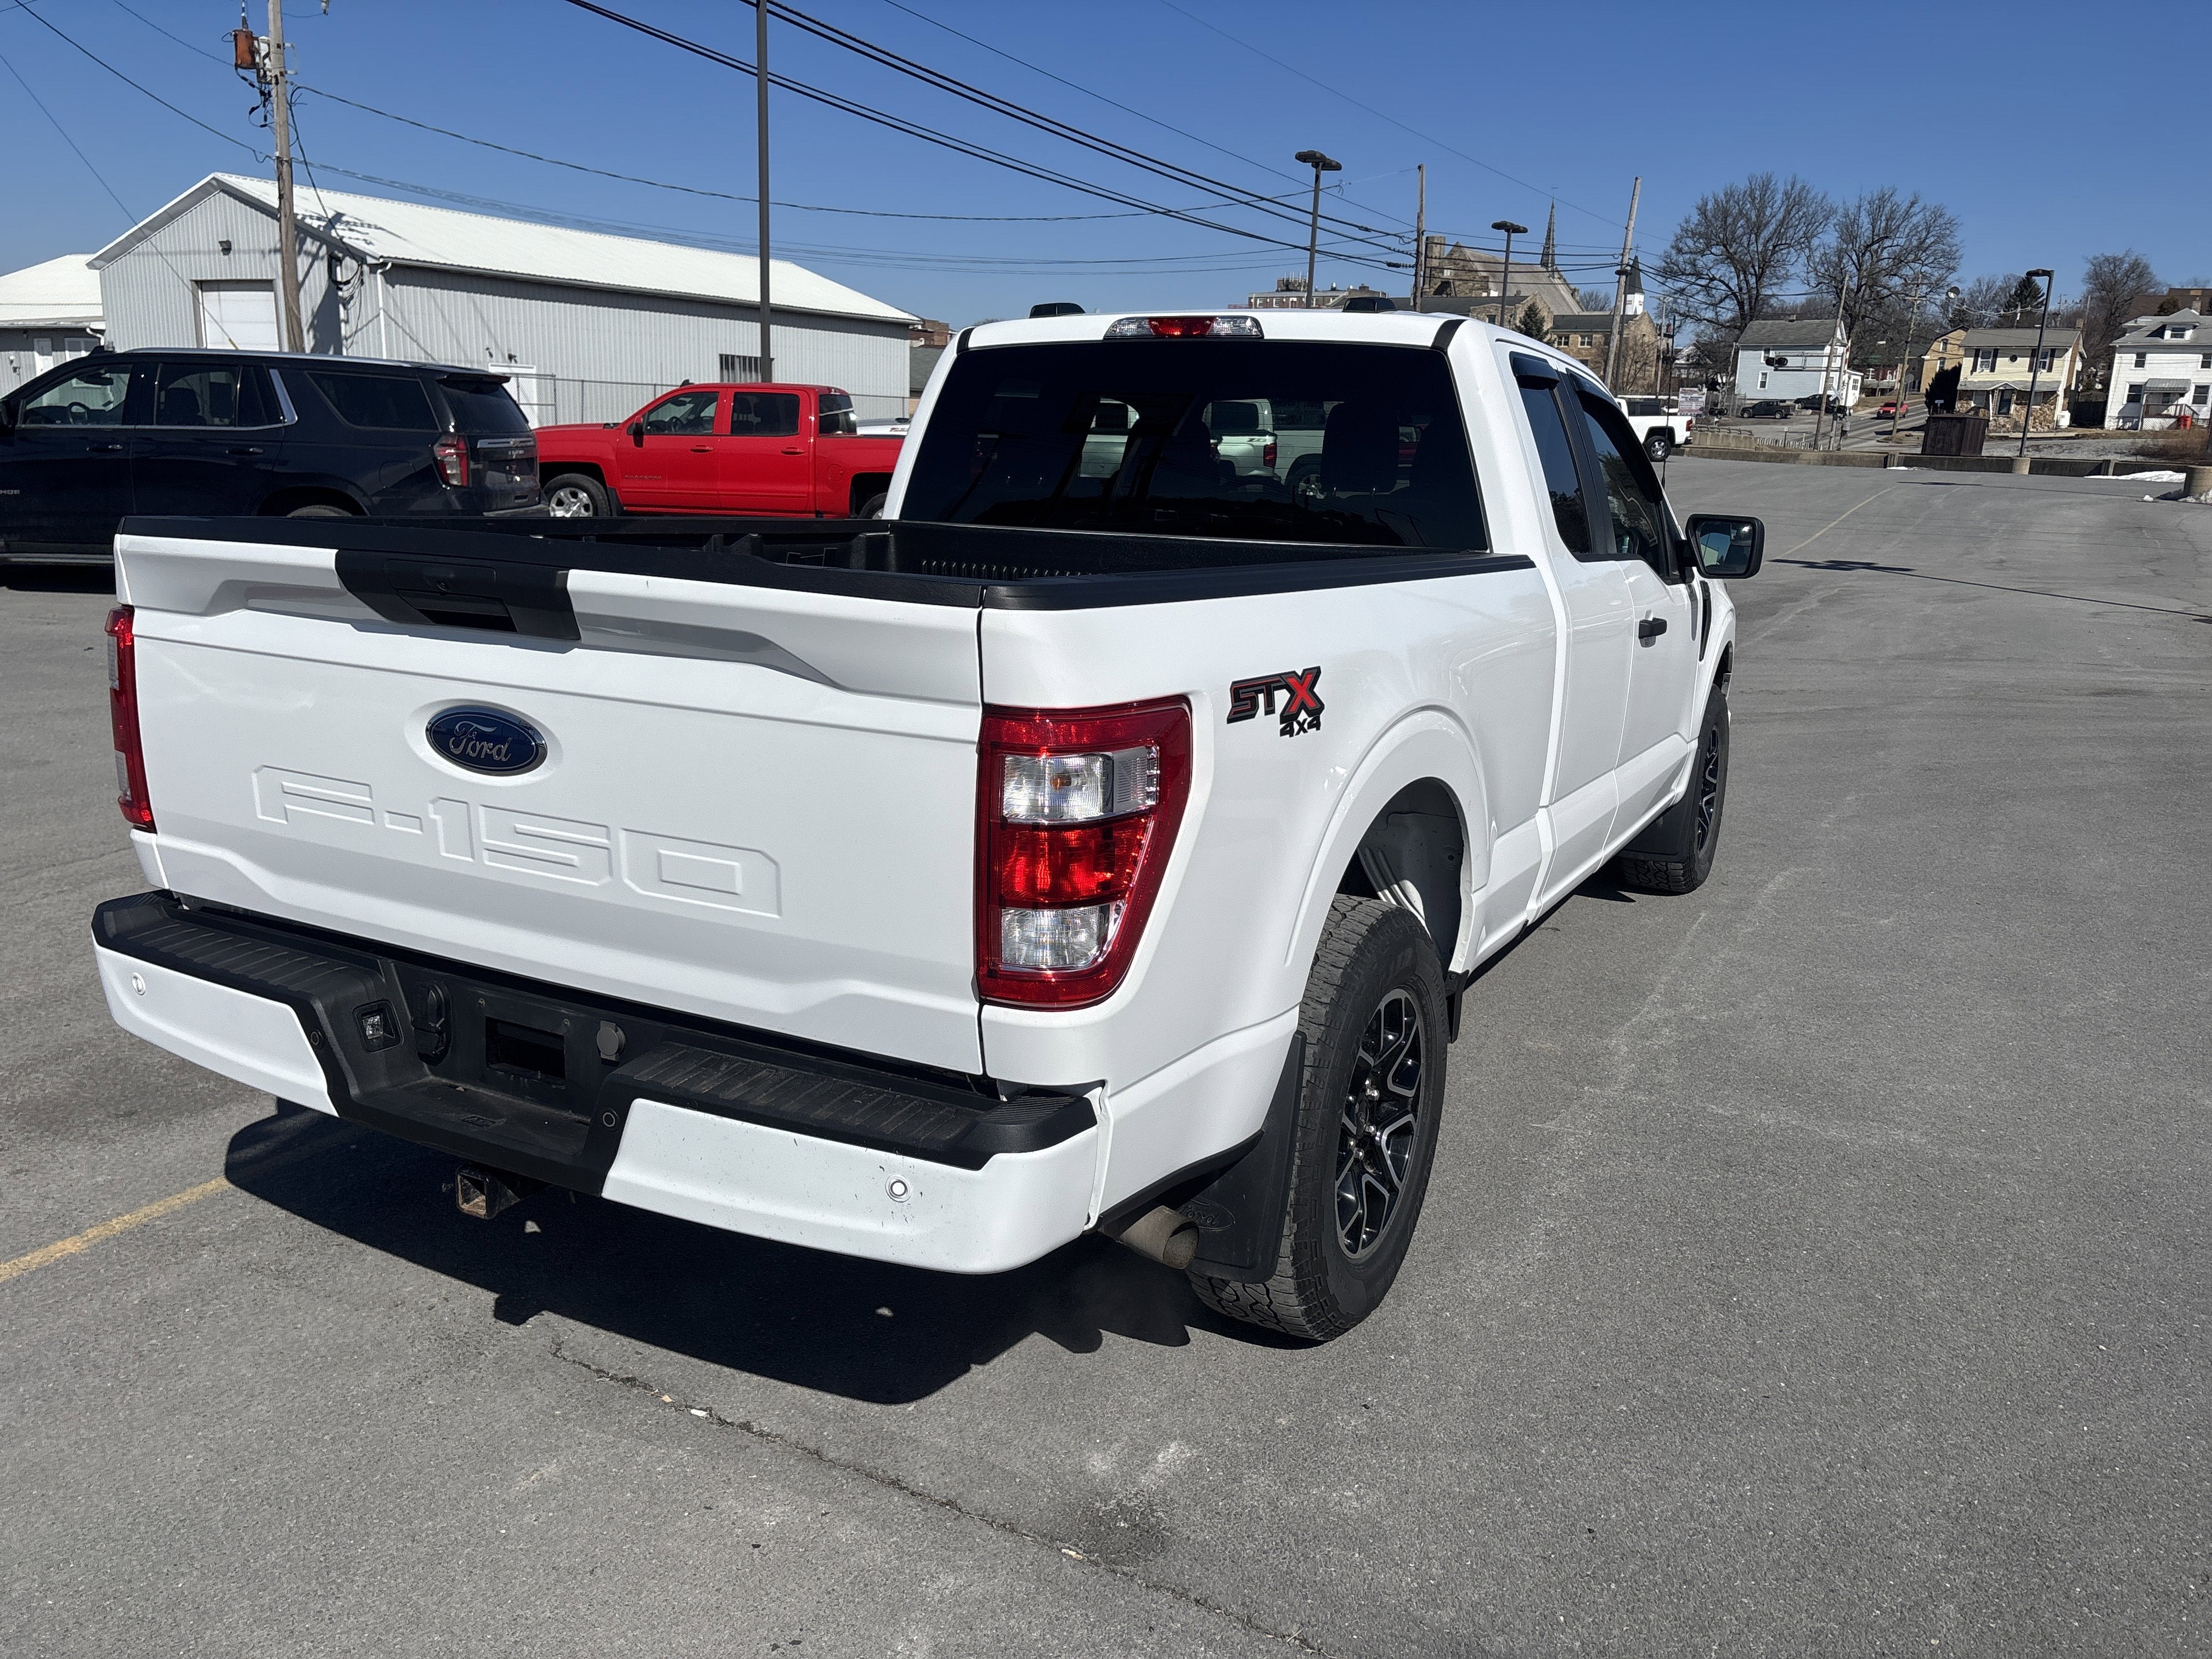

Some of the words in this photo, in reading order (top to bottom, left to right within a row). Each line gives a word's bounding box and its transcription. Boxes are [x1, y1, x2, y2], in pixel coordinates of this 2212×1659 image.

[1227, 665, 1325, 725] STX
[449, 720, 514, 761] Ford
[252, 765, 782, 919] F-150
